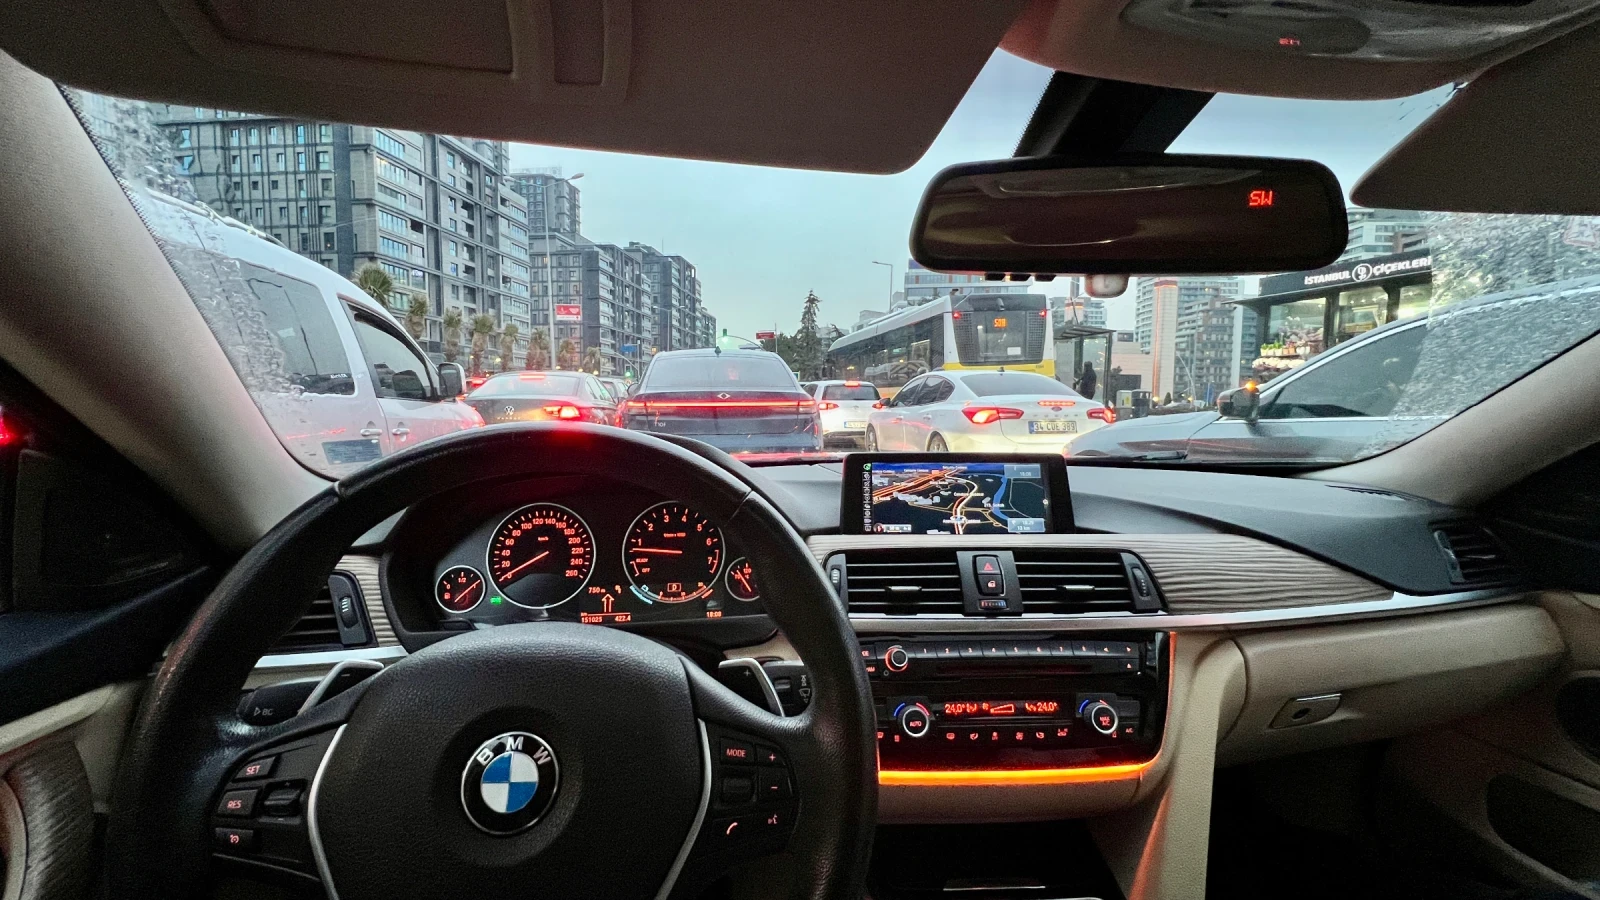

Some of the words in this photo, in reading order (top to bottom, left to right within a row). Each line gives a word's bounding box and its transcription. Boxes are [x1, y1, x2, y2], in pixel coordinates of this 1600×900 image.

[1249, 190, 1273, 206] SW
[1304, 271, 1351, 285] İSTANBUL
[1373, 256, 1432, 276] ÇİÇEKLERİ
[1034, 422, 1044, 431] 34
[1062, 422, 1076, 431] 389
[648, 523, 654, 531] 2
[697, 524, 703, 532] 5
[512, 529, 521, 537] 80
[568, 537, 580, 545] 200
[706, 538, 712, 546] 6
[501, 549, 510, 557] 40
[571, 547, 583, 555] 220
[570, 558, 582, 566] 240
[707, 556, 713, 565] 7
[565, 570, 577, 578] 260
[476, 736, 551, 766] BMW
[726, 748, 746, 757] MODE
[245, 765, 261, 775] SET
[227, 800, 242, 809] RES
